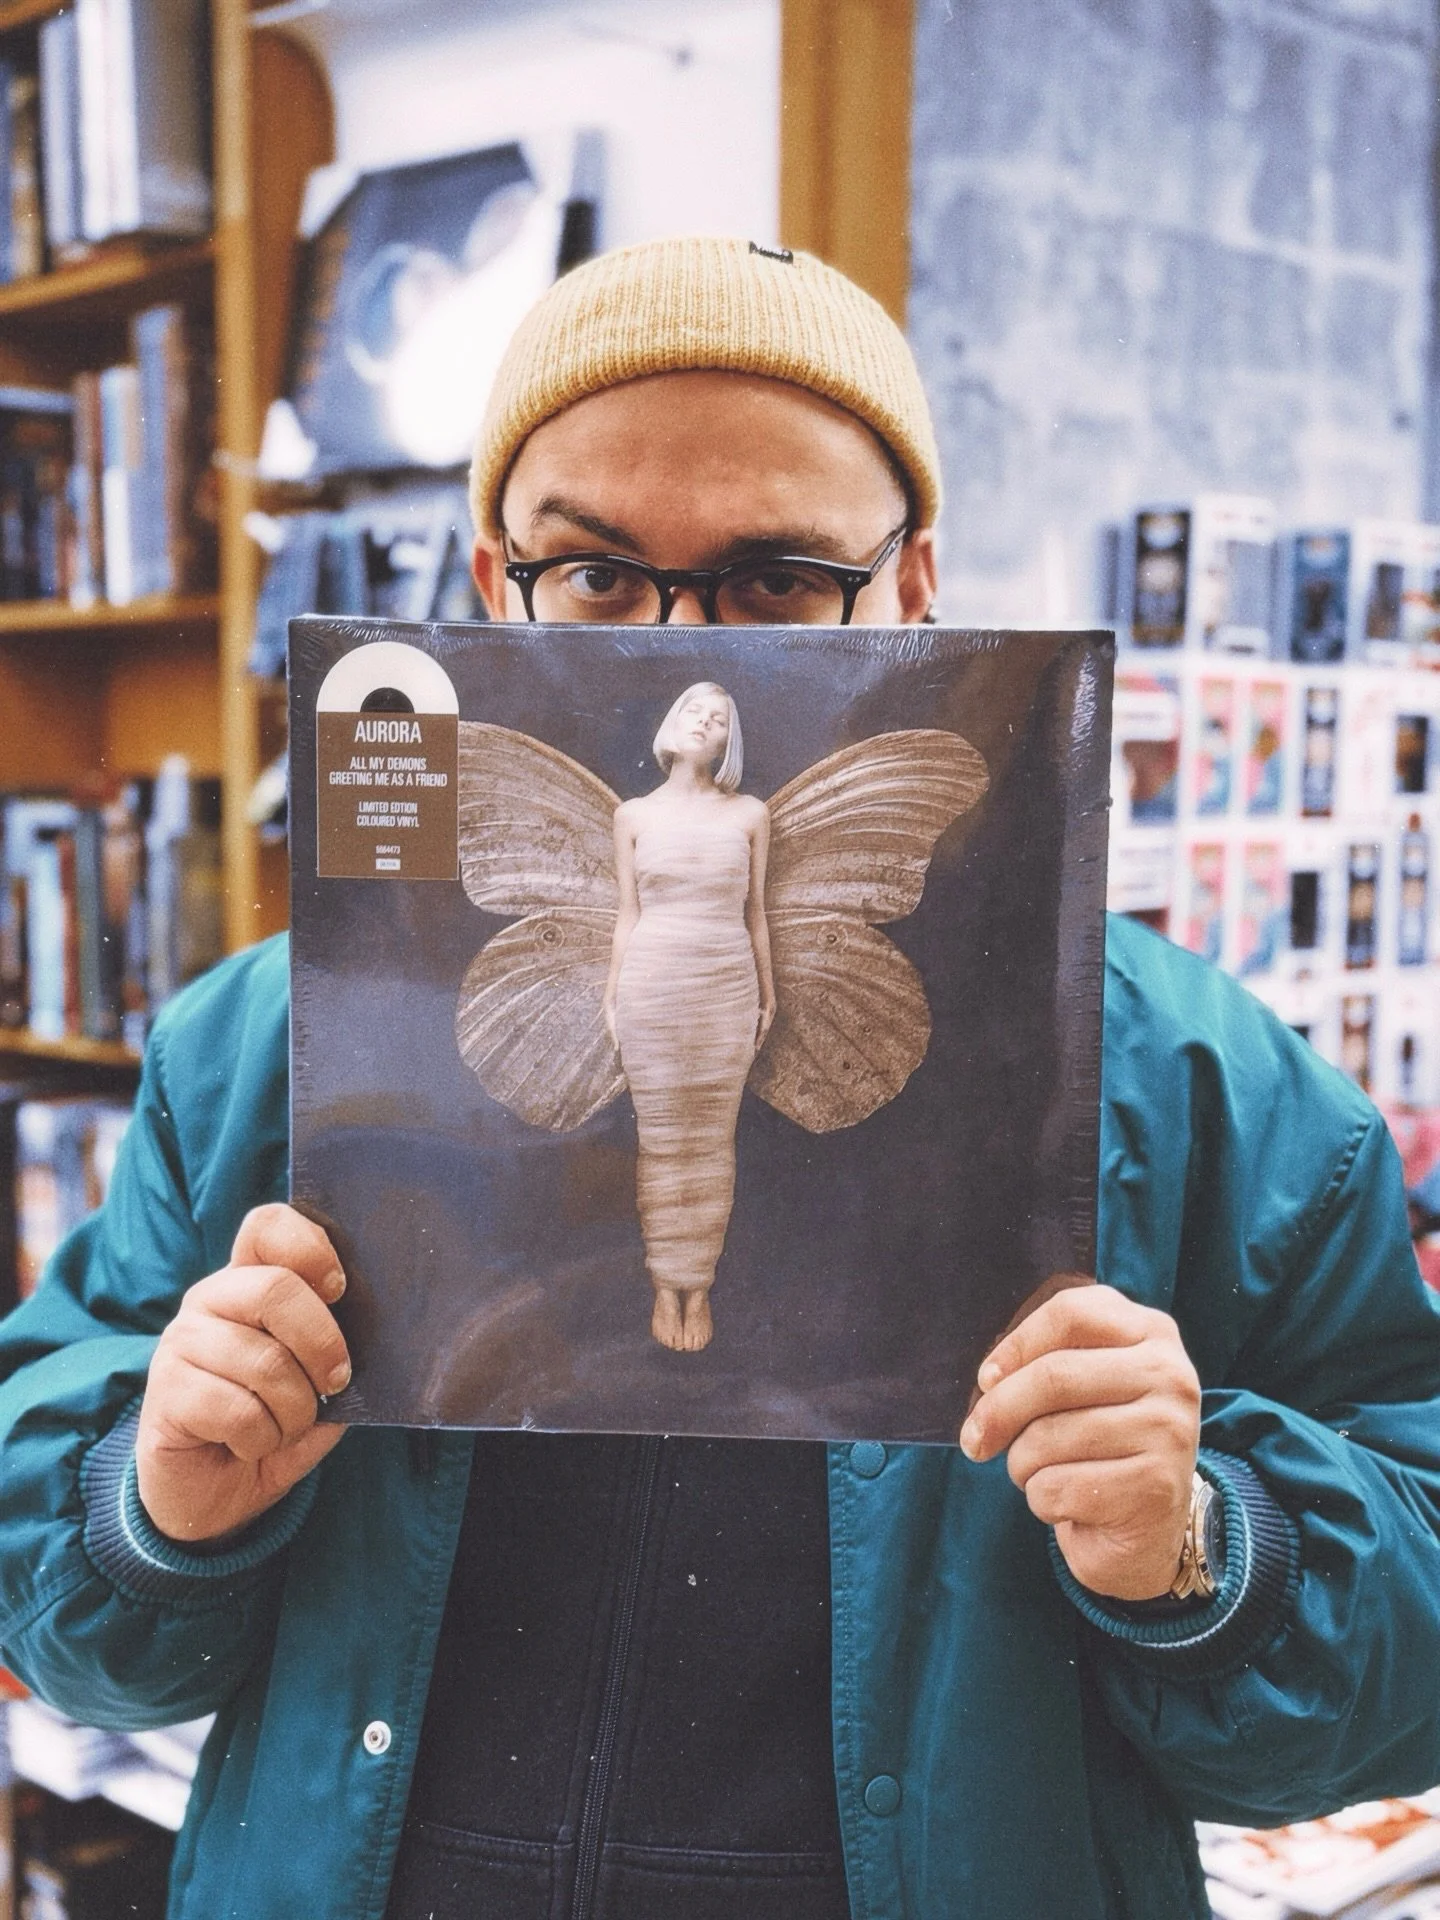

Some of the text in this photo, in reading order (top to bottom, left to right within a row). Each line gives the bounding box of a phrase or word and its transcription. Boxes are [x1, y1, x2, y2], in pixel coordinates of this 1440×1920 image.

[354, 721, 422, 743] AURORA
[350, 757, 427, 771] ALL MY DEMONS
[329, 772, 448, 787] GREETING ME AS A FRIEND
[359, 801, 389, 813] LIMITED
[357, 815, 420, 828] COLOURED VINYL
